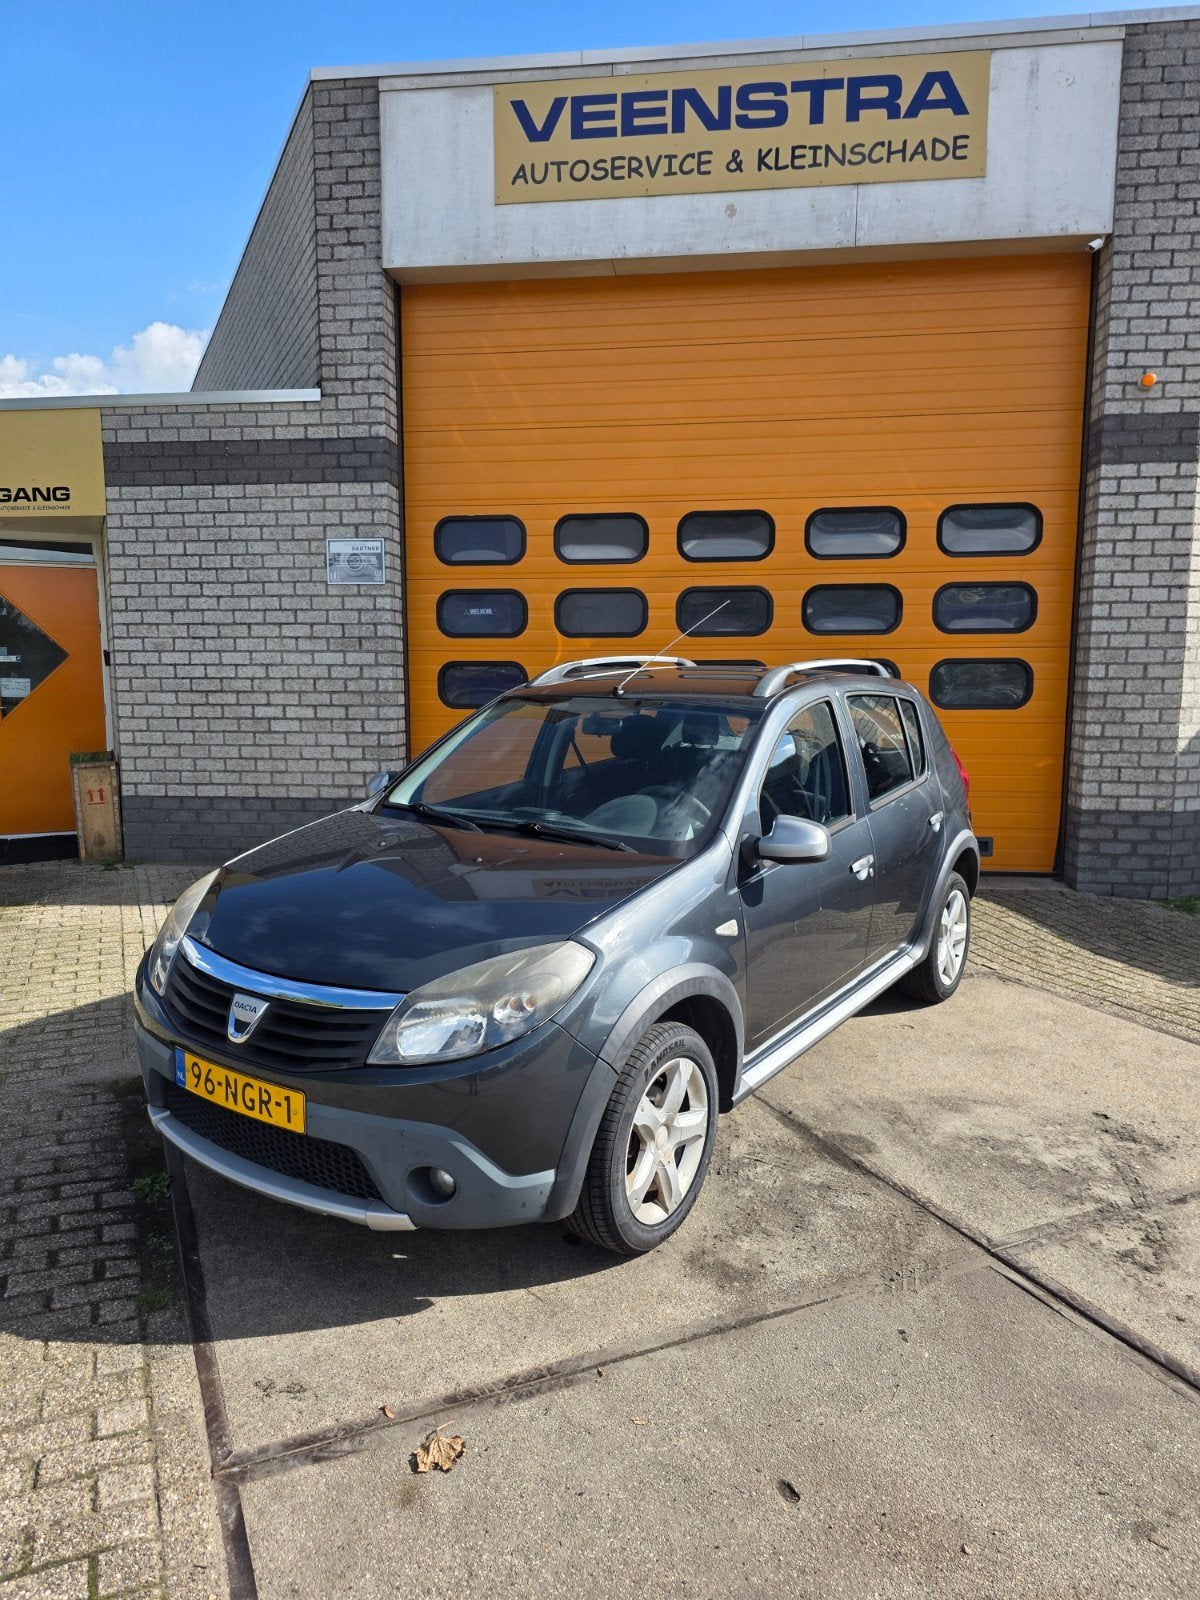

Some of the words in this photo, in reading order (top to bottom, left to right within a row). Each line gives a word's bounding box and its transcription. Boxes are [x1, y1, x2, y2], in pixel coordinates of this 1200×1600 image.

[509, 70, 970, 142] VEENSTRA
[511, 149, 714, 186] AUTOSERVICE
[725, 149, 744, 173] &
[756, 134, 971, 173] KLEINSCHADE
[0, 486, 71, 502] GANG
[233, 1000, 258, 1014] DACIA
[177, 1070, 185, 1081] NL
[190, 1061, 292, 1124] 96-NGR-1
